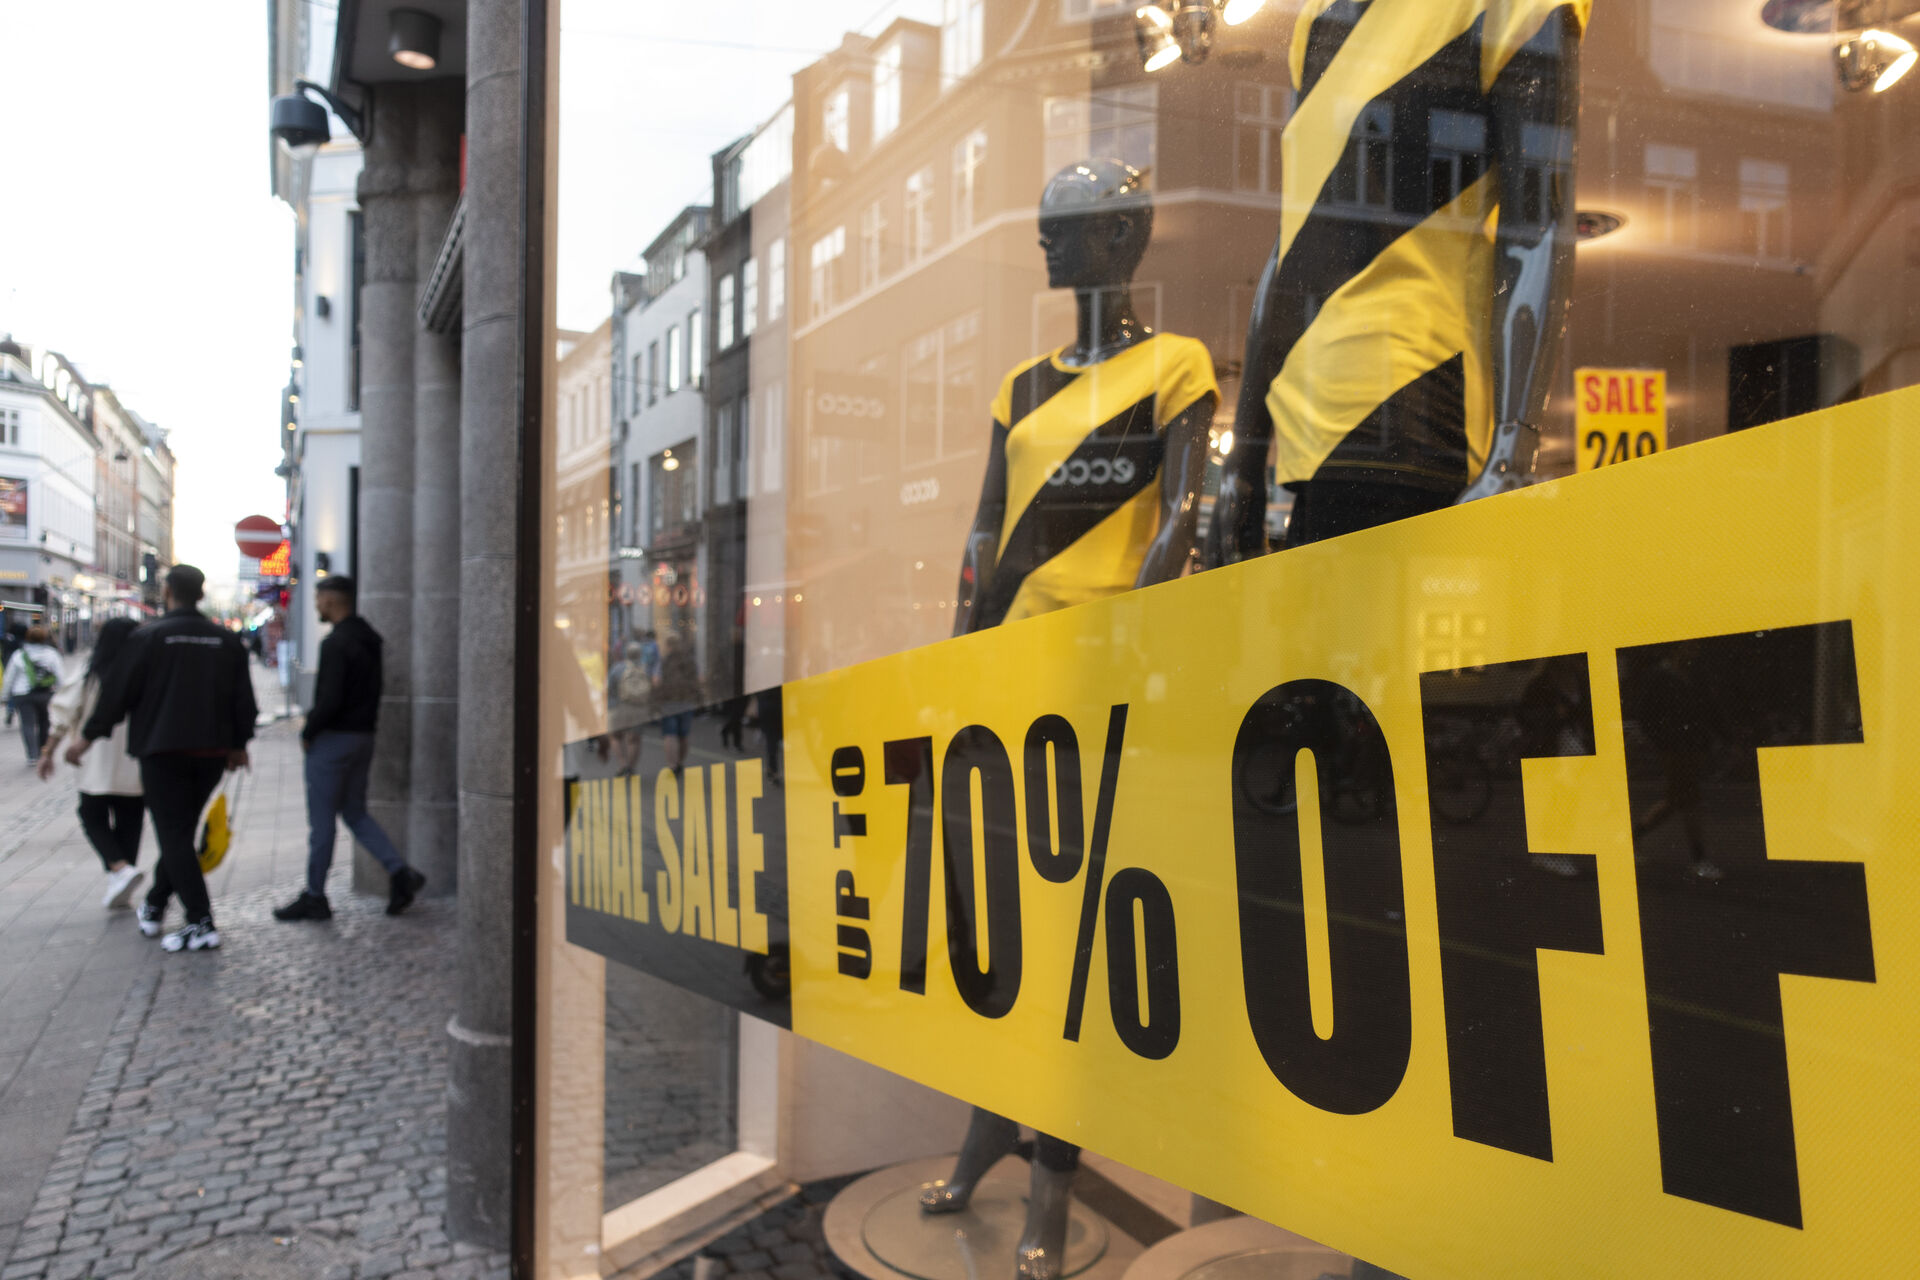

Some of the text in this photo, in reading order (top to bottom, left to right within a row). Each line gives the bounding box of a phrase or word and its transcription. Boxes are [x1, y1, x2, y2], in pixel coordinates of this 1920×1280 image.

[1584, 376, 1656, 413] SALE
[570, 758, 769, 955] FINAL SALE
[831, 745, 872, 980] UP TO
[883, 619, 1876, 1231] 70% OFF
